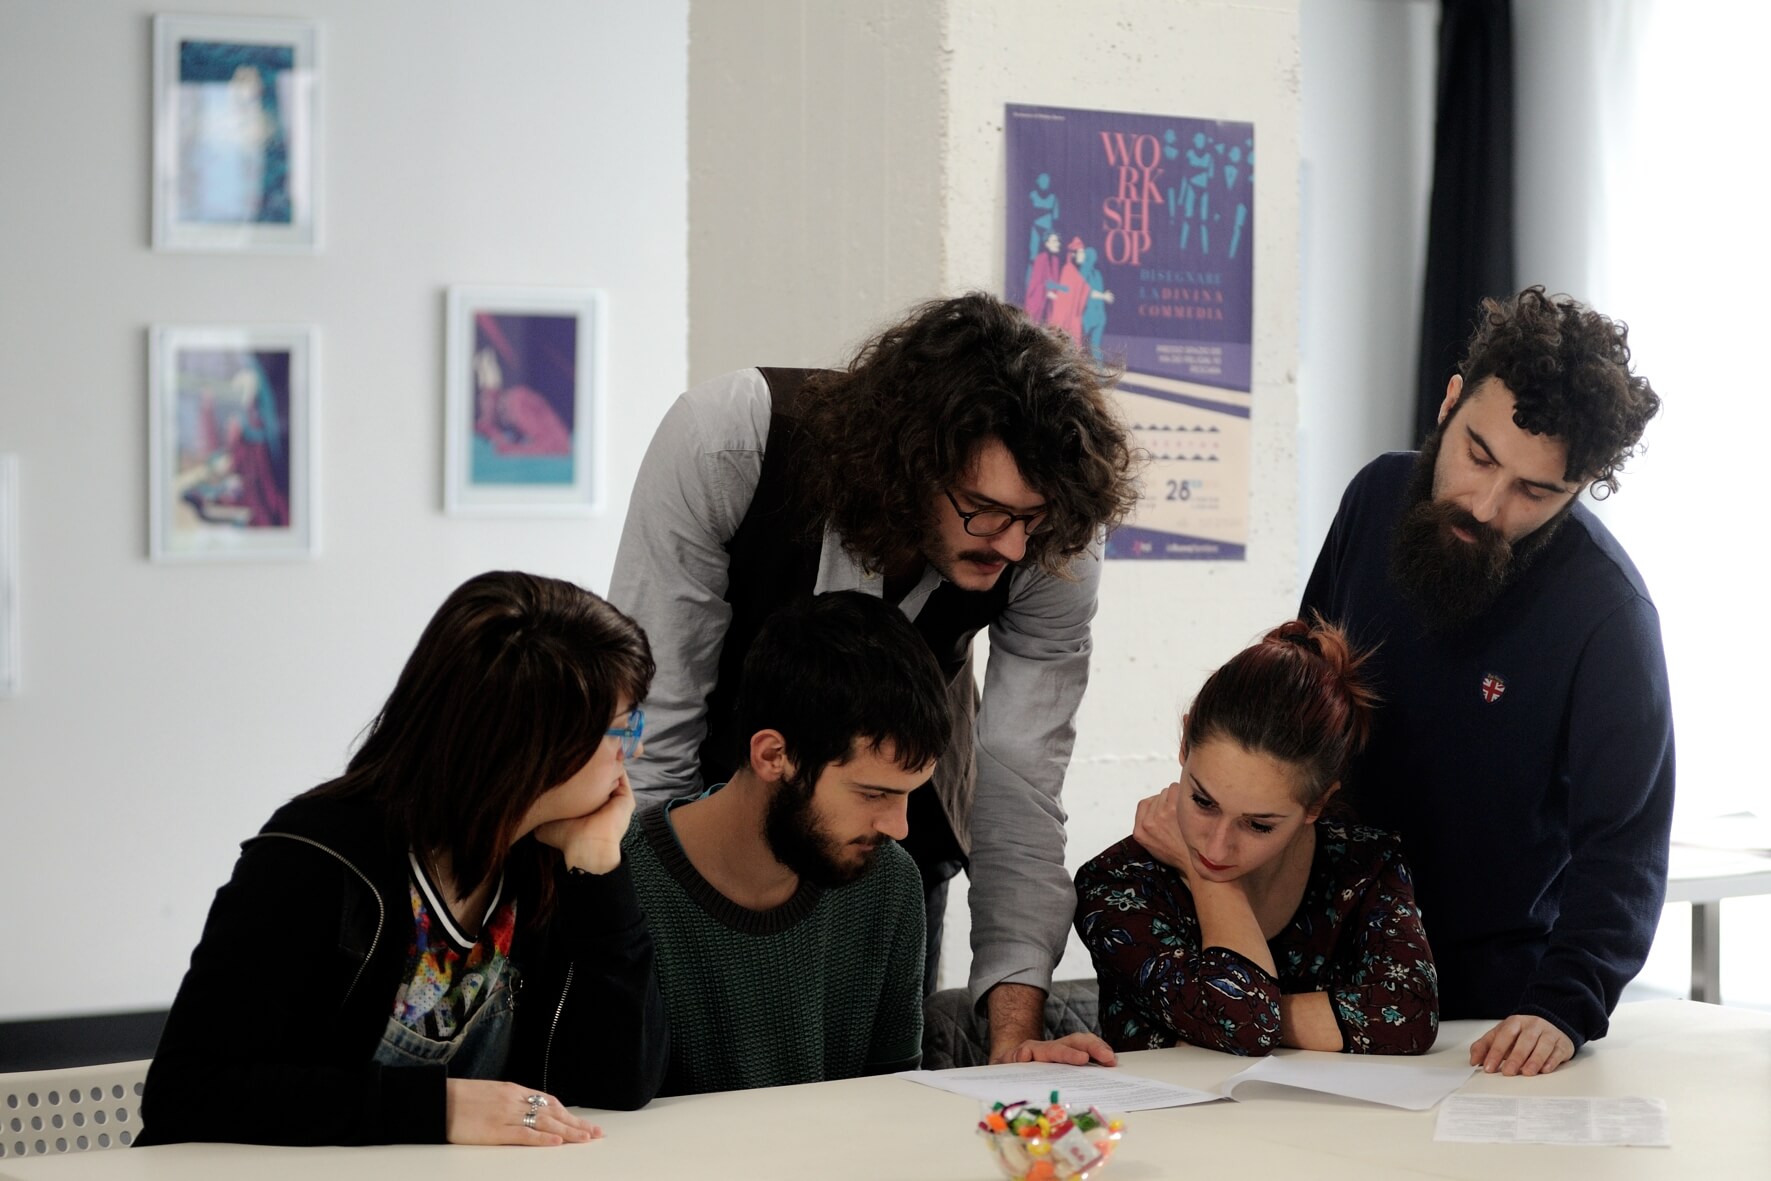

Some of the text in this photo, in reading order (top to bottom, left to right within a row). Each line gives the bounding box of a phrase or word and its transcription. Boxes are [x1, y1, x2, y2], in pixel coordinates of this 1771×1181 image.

[1100, 132, 1162, 171] WO
[1117, 165, 1165, 204] RK
[1102, 197, 1150, 233] SH
[1105, 230, 1152, 266] OP
[1140, 269, 1222, 284] DISEGNARE
[1138, 304, 1223, 320] COMMEDIA
